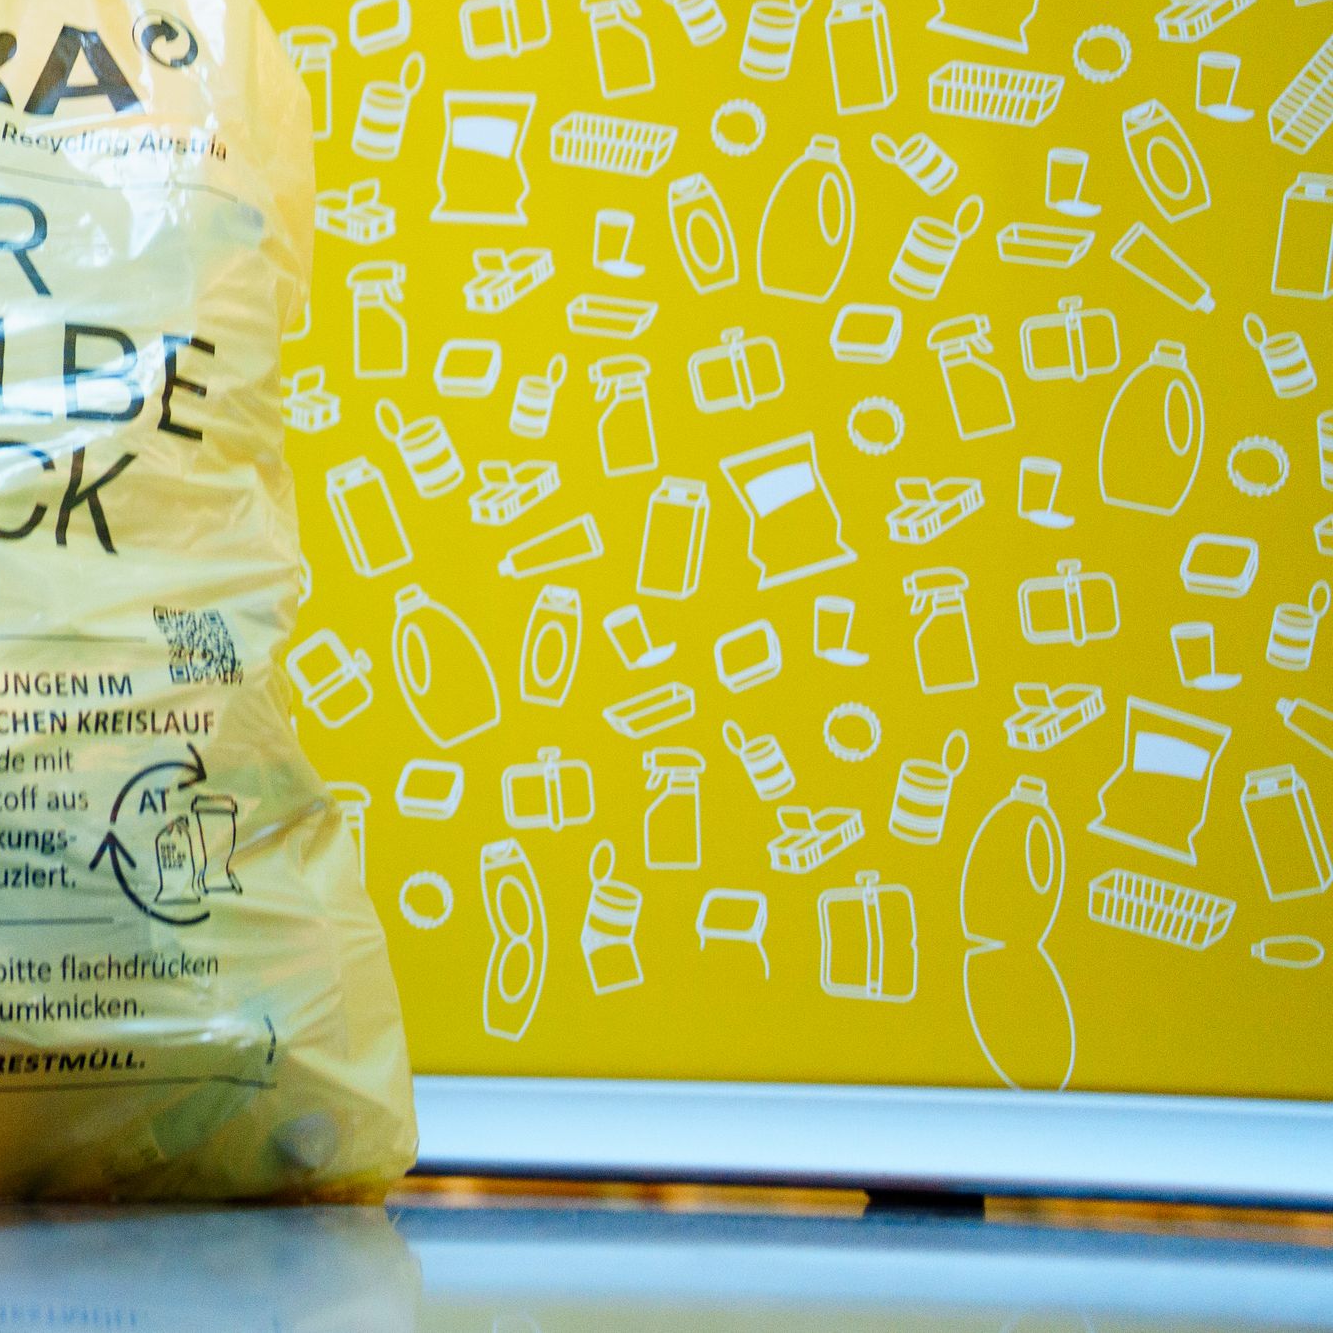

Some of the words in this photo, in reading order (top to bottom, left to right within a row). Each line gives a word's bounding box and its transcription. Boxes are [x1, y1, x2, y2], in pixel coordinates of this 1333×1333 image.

[1, 121, 131, 158] Recycling
[137, 130, 229, 162] Austria
[98, 672, 134, 698] IM
[76, 709, 217, 737] KREISLAUF
[33, 747, 74, 775] mit
[46, 791, 90, 812] aus
[138, 788, 170, 815] AT
[59, 951, 220, 983] flachdrücken
